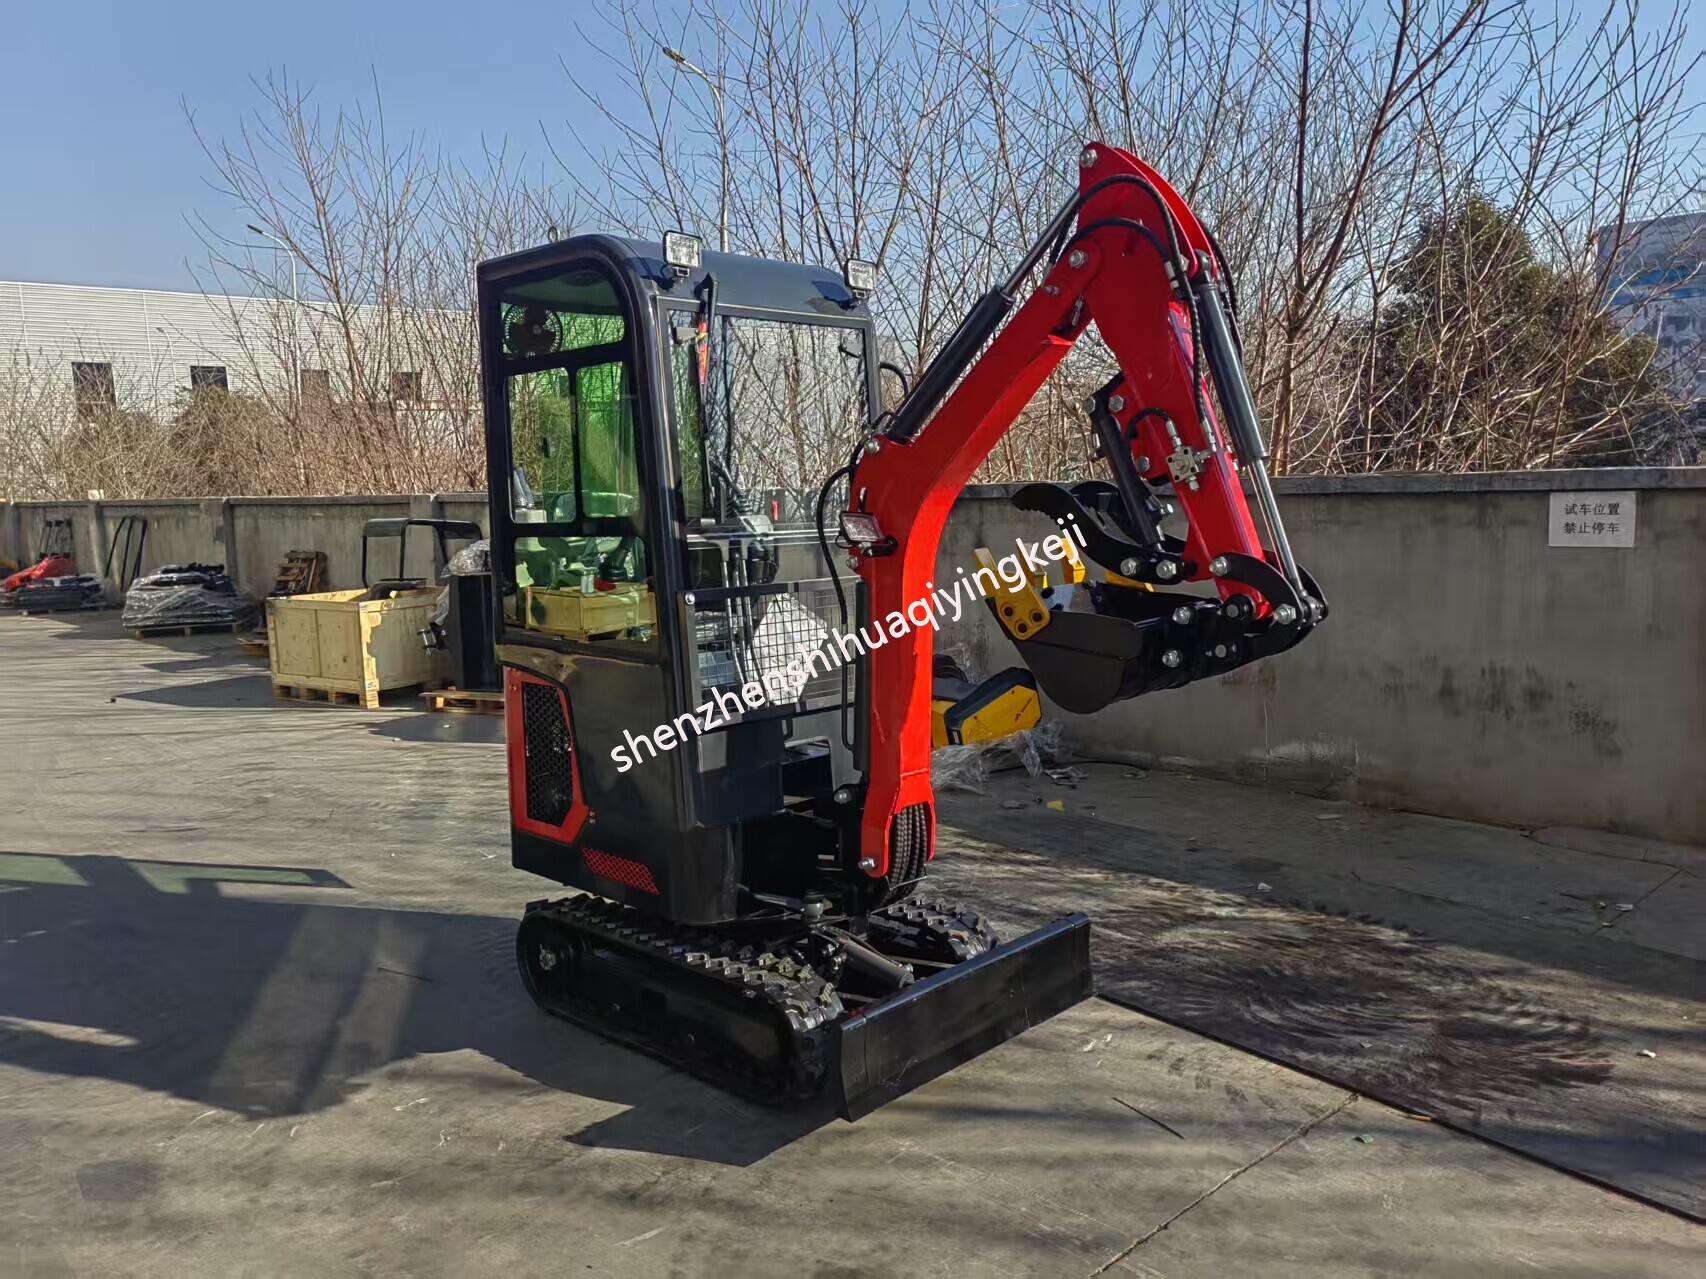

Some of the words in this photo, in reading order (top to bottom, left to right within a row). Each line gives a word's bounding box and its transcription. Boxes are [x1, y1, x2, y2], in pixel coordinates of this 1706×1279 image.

[1564, 503, 1620, 516] 试车位置
[1563, 521, 1620, 534] 禁止停车
